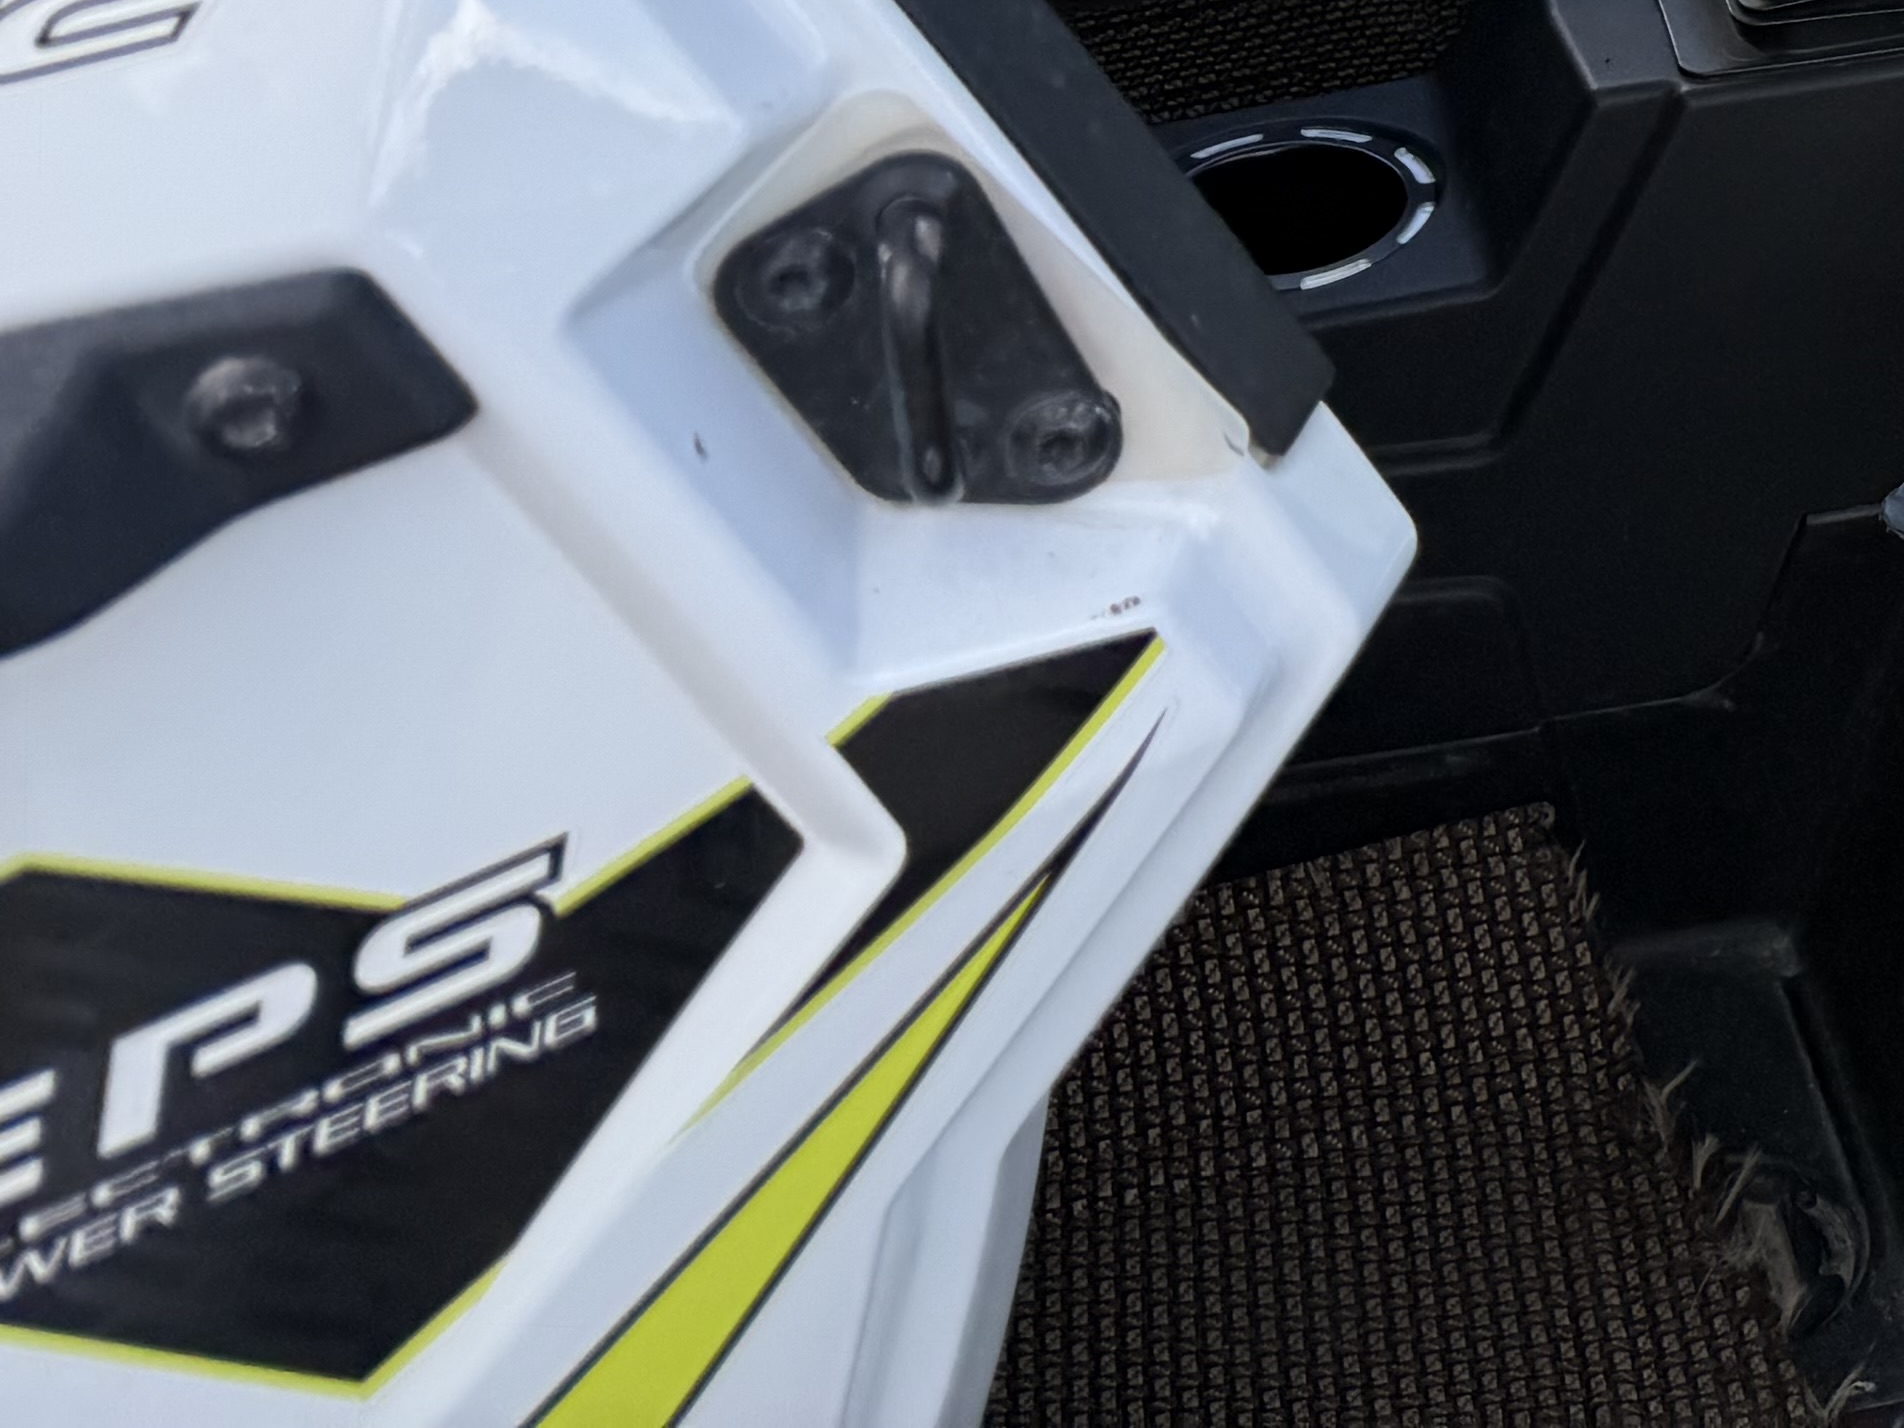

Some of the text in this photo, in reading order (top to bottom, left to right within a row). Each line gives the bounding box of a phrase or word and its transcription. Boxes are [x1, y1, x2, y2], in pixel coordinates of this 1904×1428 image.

[0, 971, 577, 1257] ECTRONIC
[0, 994, 598, 1302] WER STEERING
